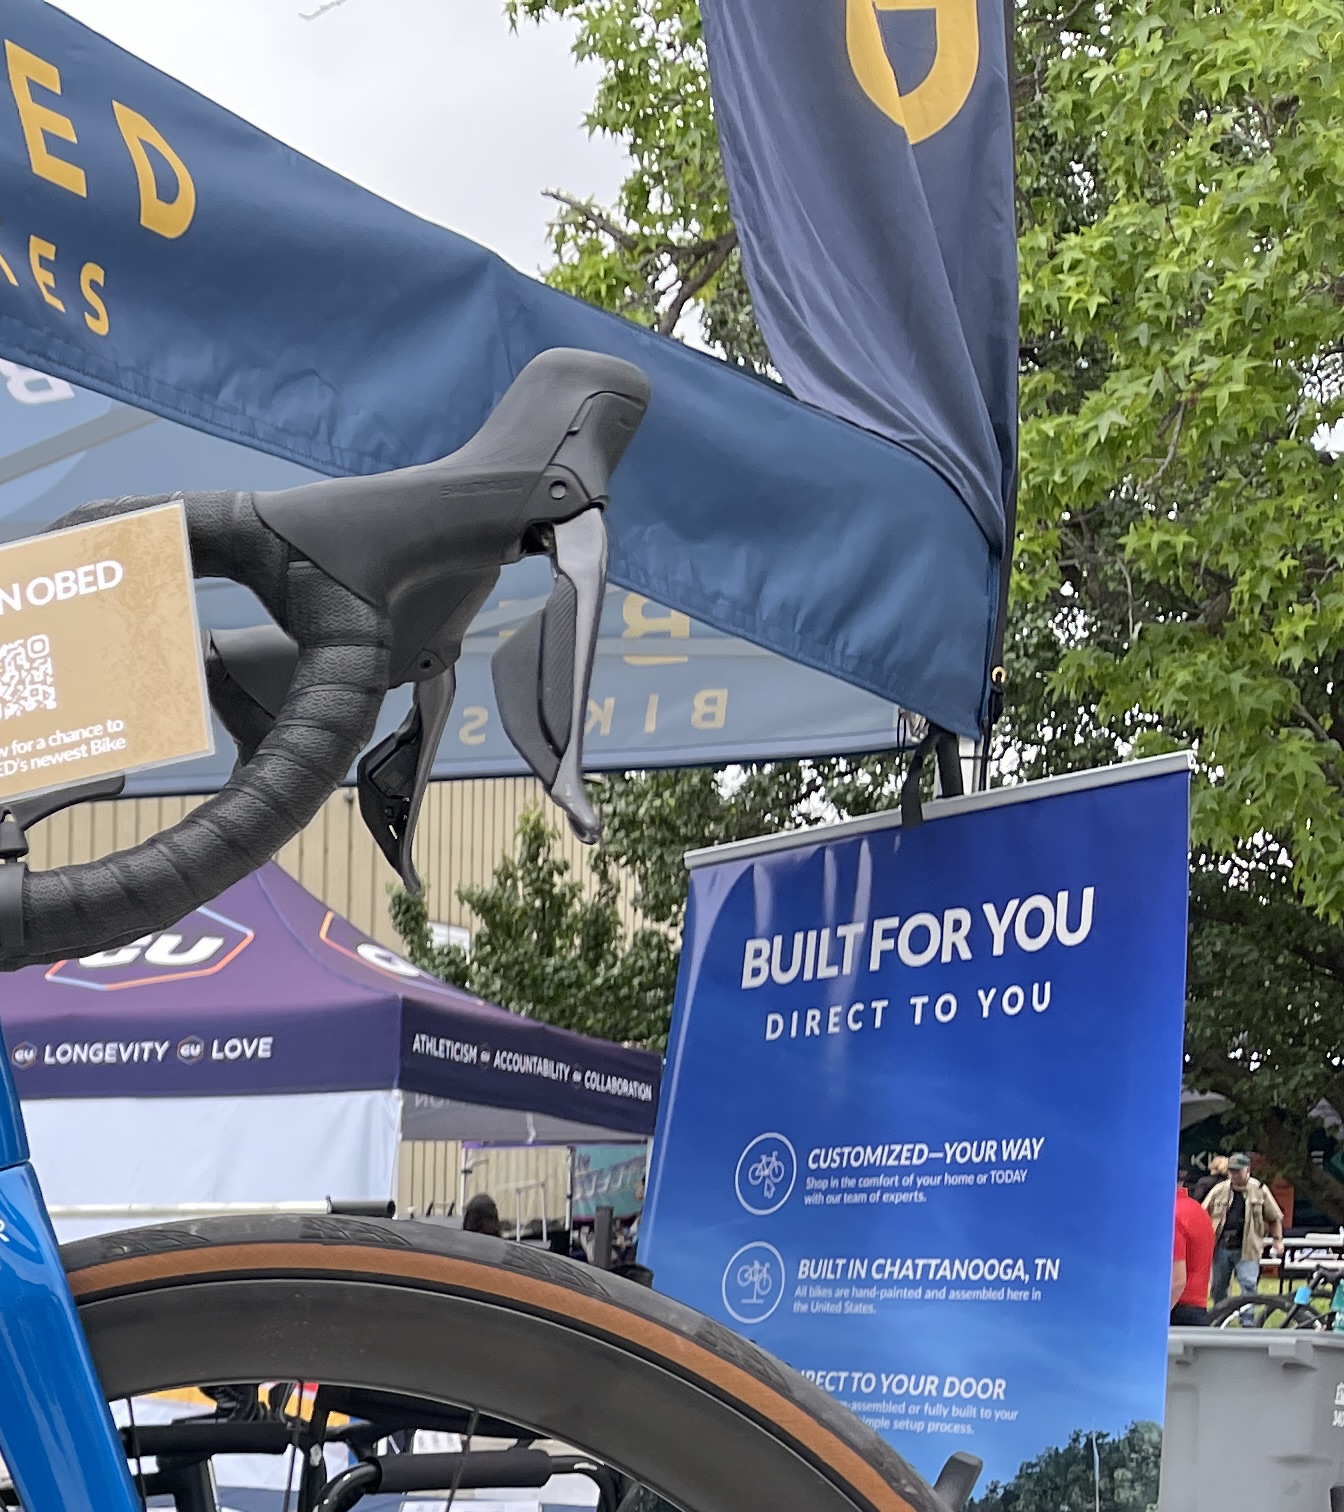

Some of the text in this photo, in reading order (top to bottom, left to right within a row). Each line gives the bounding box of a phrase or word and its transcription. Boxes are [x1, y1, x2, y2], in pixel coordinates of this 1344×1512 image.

[25, 559, 124, 607] OBED
[11, 736, 34, 757] for
[36, 738, 47, 751] a
[48, 723, 104, 749] chance
[106, 718, 124, 735] to
[30, 744, 88, 768] newest
[91, 733, 126, 754] Bike
[741, 886, 1095, 990] BUILT FOR YOU
[765, 981, 1052, 1041] DIRECT TO YOU
[44, 1040, 171, 1066] LONGEVITY
[212, 1036, 275, 1060] LOVE
[412, 1032, 479, 1065] ATHLETICISM
[493, 1050, 571, 1083] ACCOUNTABILITY
[584, 1069, 653, 1101] COLLABORATION
[1001, 1137, 1045, 1161] WAY
[841, 1175, 857, 1187] the
[858, 1174, 900, 1188] comfort
[901, 1173, 915, 1186] of
[915, 1173, 942, 1187] your
[944, 1172, 974, 1186] home
[976, 1173, 988, 1184] or
[989, 1169, 1028, 1184] TODAY
[843, 1192, 868, 1204] team
[869, 1191, 881, 1204] of
[882, 1191, 927, 1206] experts.
[798, 1258, 1060, 1284] BUILT IN CHATTANOOGA, TN
[843, 1302, 877, 1314] States.
[851, 1287, 922, 1301] hand-painted
[925, 1287, 946, 1299] and
[948, 1287, 1005, 1300] assembled
[1006, 1287, 1029, 1300] here
[1031, 1287, 1042, 1300] in
[800, 1370, 1007, 1400] RECT TO YOUR DOOR
[908, 1406, 920, 1415] or
[923, 1403, 949, 1418] fully
[951, 1405, 977, 1418] built
[979, 1408, 992, 1420] to
[994, 1410, 1019, 1422] your
[892, 1420, 925, 1434] setup
[927, 1422, 976, 1436] process.
